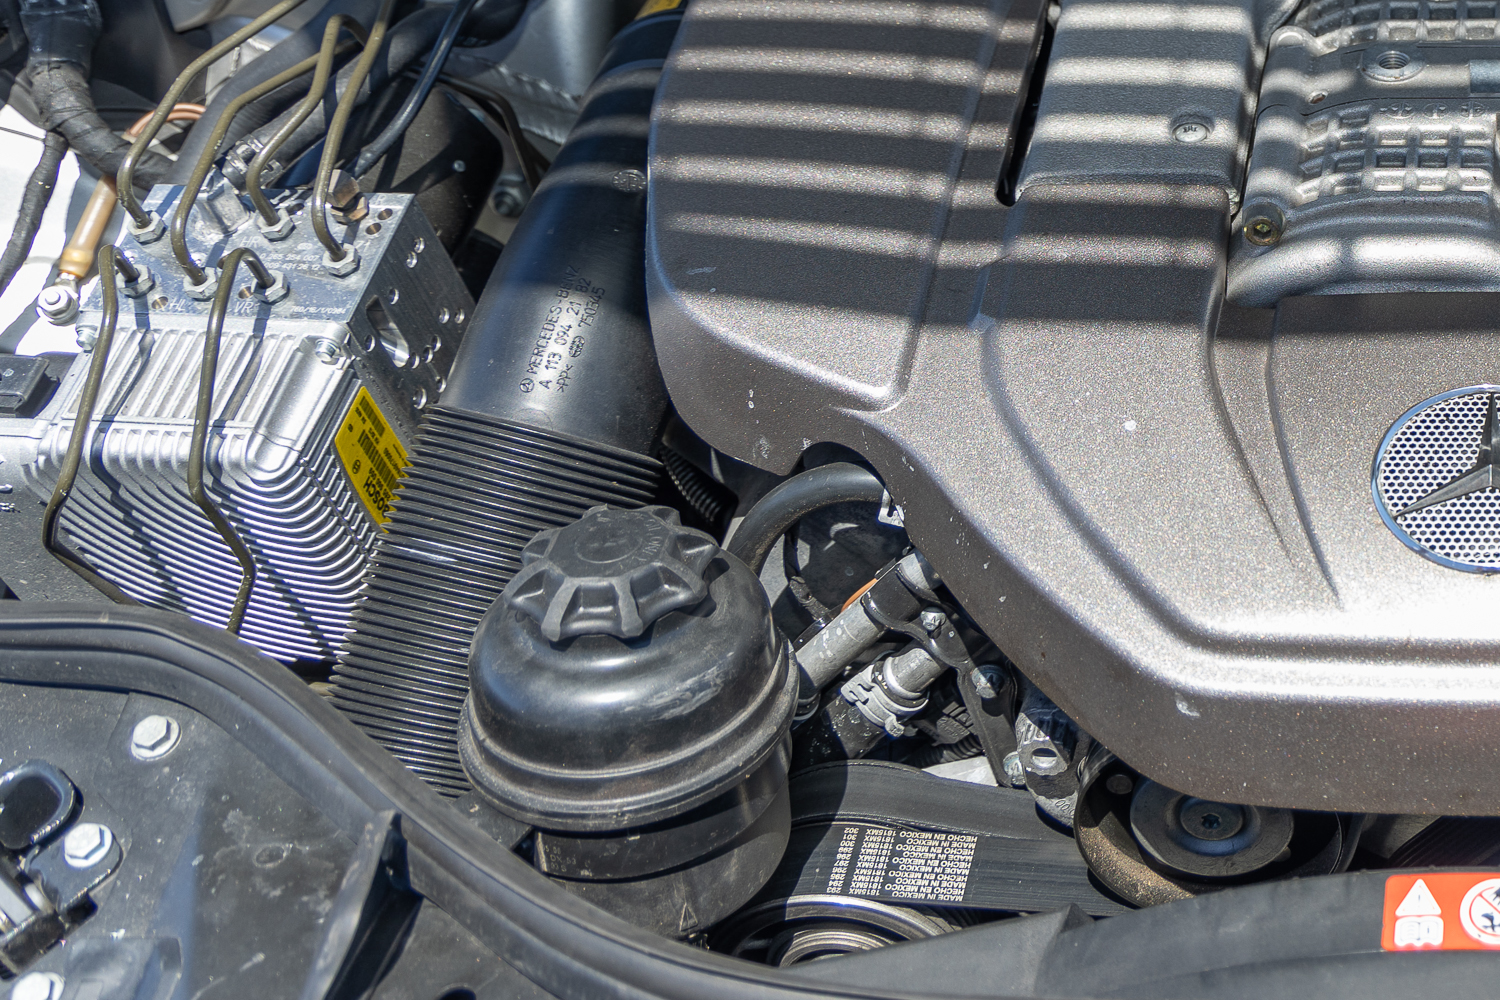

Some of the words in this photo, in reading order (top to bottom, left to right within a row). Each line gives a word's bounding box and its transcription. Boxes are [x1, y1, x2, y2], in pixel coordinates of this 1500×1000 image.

[526, 264, 580, 375] MERCEDES-BENZ
[538, 379, 552, 389] A
[545, 352, 562, 370] 113
[554, 324, 573, 346] 094
[566, 301, 582, 316] 21
[575, 277, 592, 293] 82
[900, 831, 932, 839] MEXICO
[906, 838, 939, 846] MEXICO
[860, 848, 891, 856] 1815MX
[896, 844, 929, 852] MEXICO
[903, 851, 936, 859] MEXICO
[892, 857, 925, 865] MEXICO
[885, 884, 918, 892] MEXICO
[934, 887, 965, 895] HECHO
[892, 891, 925, 899] MEXICO
